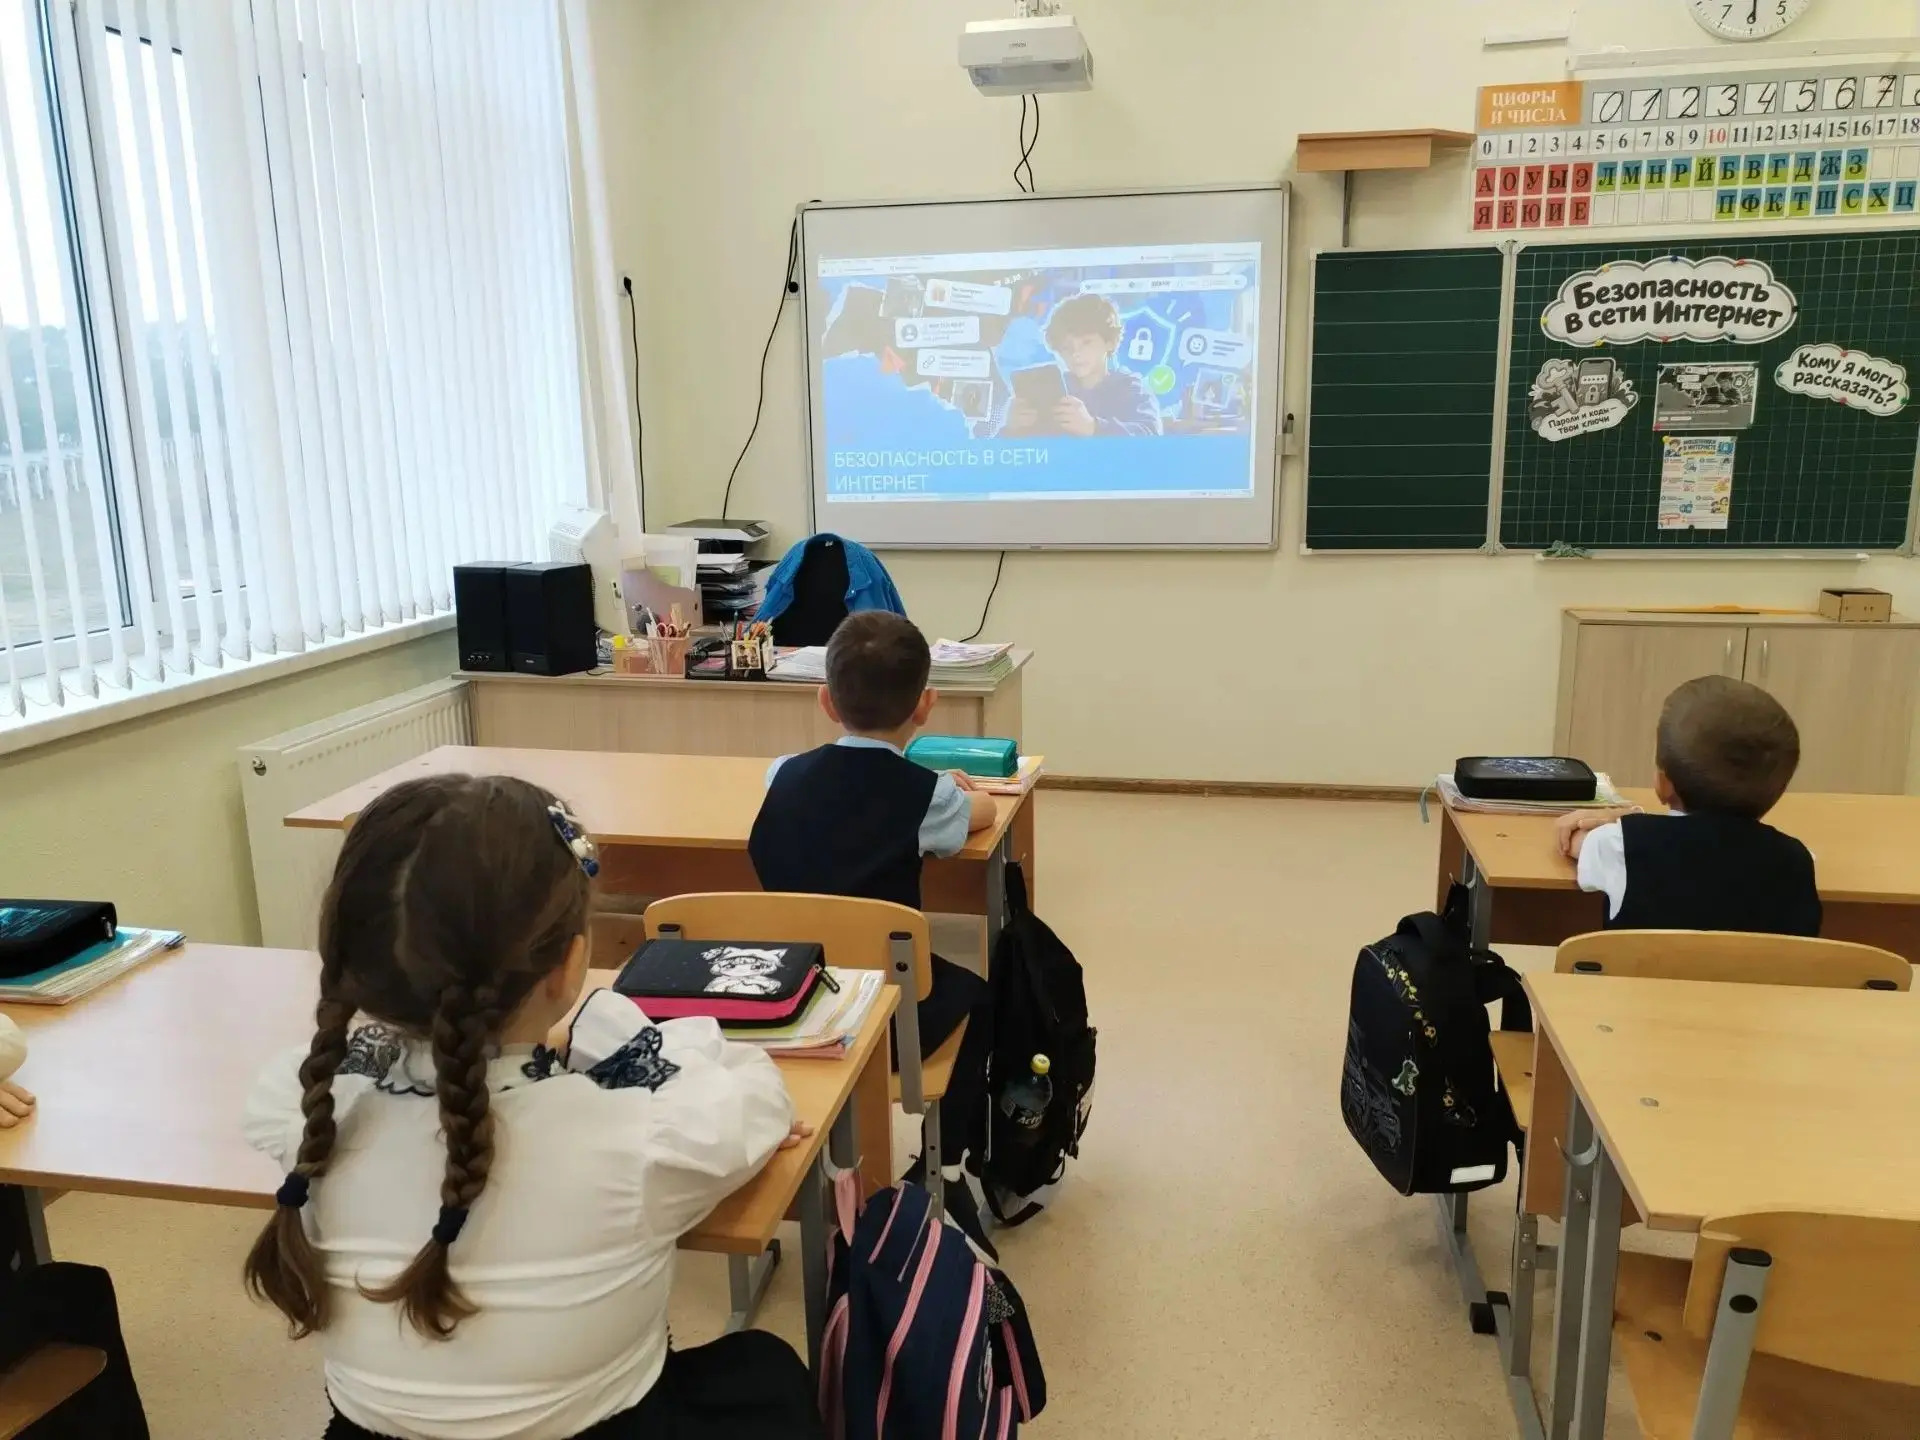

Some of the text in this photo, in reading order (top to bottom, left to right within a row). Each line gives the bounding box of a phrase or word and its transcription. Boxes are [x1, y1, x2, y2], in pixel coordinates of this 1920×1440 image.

[1722, 0, 1786, 19] 7 5
[1492, 90, 1556, 108] ЦИФРЫ
[1600, 91, 1624, 122] 0
[1643, 88, 1662, 120] 1
[1678, 86, 1700, 118] 2
[1717, 84, 1738, 116] 3
[1758, 82, 1777, 114] 4
[1796, 79, 1818, 112] 5
[1836, 77, 1857, 109] 6
[1876, 74, 1897, 108] 7
[1491, 108, 1567, 124] И ЧИСЛА
[1483, 118, 1920, 155] 0 1 2 3 4 5 6 7 8 9 10 11 12 13 14 15 16 17 18
[1478, 155, 1863, 192] А О У Ы Э Л М Н Р Й Б В Г Д Ж З
[1477, 186, 1914, 224] Я Ё Ю И Е П Ф К Т Ш С Х Ц
[1573, 278, 1770, 310] Безопасность
[1588, 304, 1647, 328] сети
[1652, 300, 1783, 329] Интернет
[1797, 352, 1841, 374] Кому
[1857, 366, 1898, 391] могу
[1793, 372, 1898, 407] рассказать?
[1548, 416, 1579, 428] Пароли
[1589, 408, 1609, 417] коды
[1558, 416, 1610, 435] твои ключи
[833, 448, 1049, 468] БЕЗОПАСНОСТЬ В СЕТИ
[835, 474, 929, 492] ИНТЕРНЕТ
